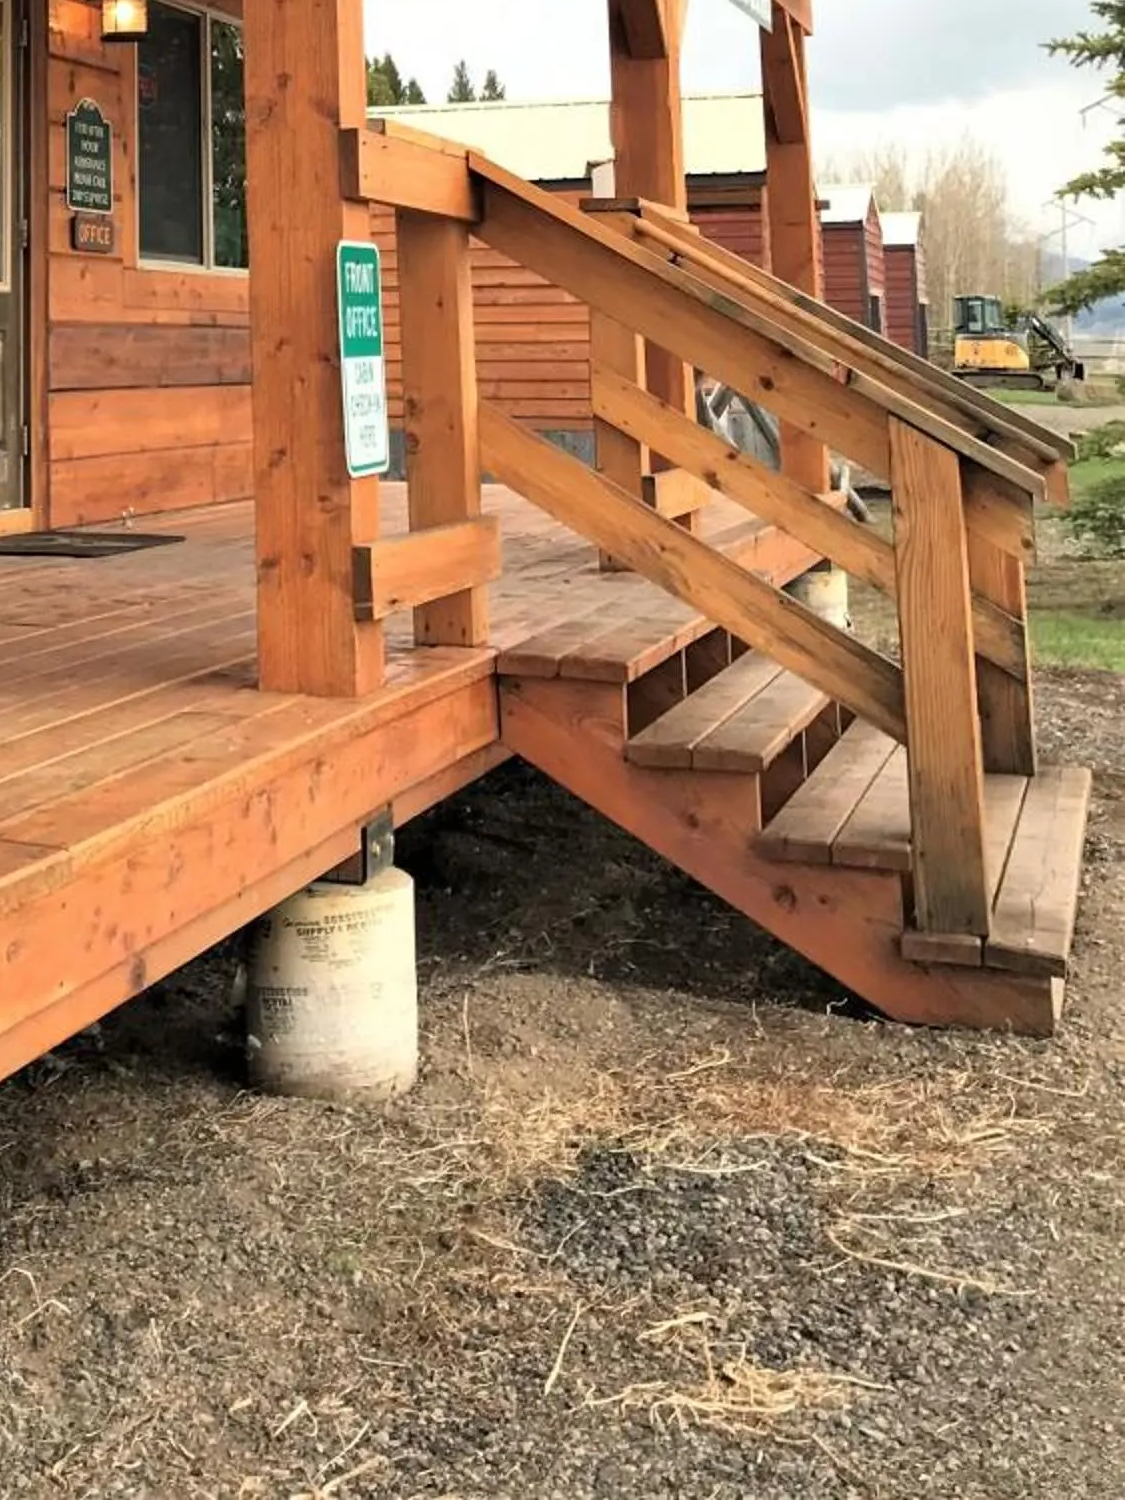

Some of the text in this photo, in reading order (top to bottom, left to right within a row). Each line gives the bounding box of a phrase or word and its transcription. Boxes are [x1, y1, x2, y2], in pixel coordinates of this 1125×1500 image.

[78, 223, 111, 246] OFFICE
[344, 263, 374, 293] FRONT
[346, 305, 378, 339] OFFICE
